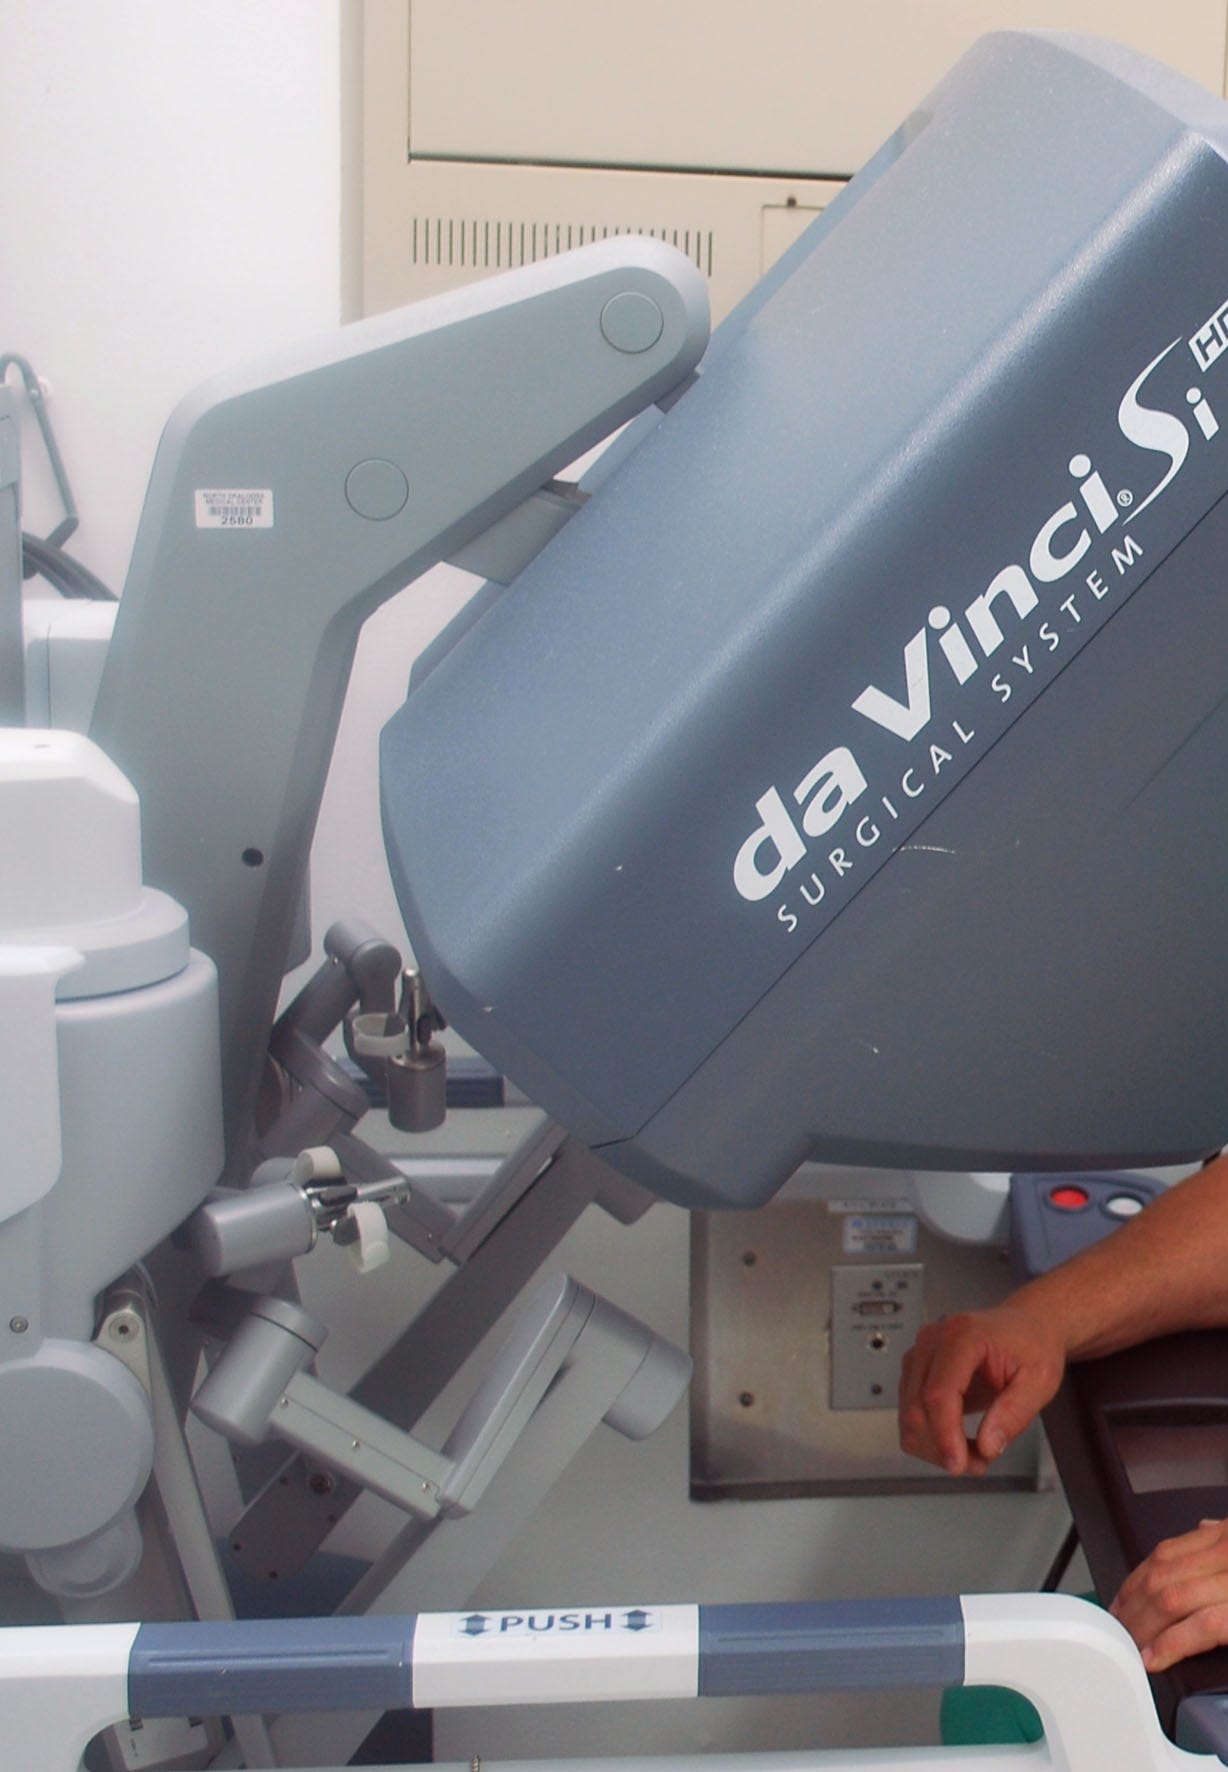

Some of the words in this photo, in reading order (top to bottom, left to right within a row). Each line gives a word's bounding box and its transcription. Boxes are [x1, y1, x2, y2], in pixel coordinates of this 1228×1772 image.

[733, 746, 868, 901] da
[1118, 336, 1219, 525] Si
[777, 720, 975, 933] SURGICAL
[991, 534, 1143, 703] SYSTEM
[500, 1613, 612, 1632] PUSH
